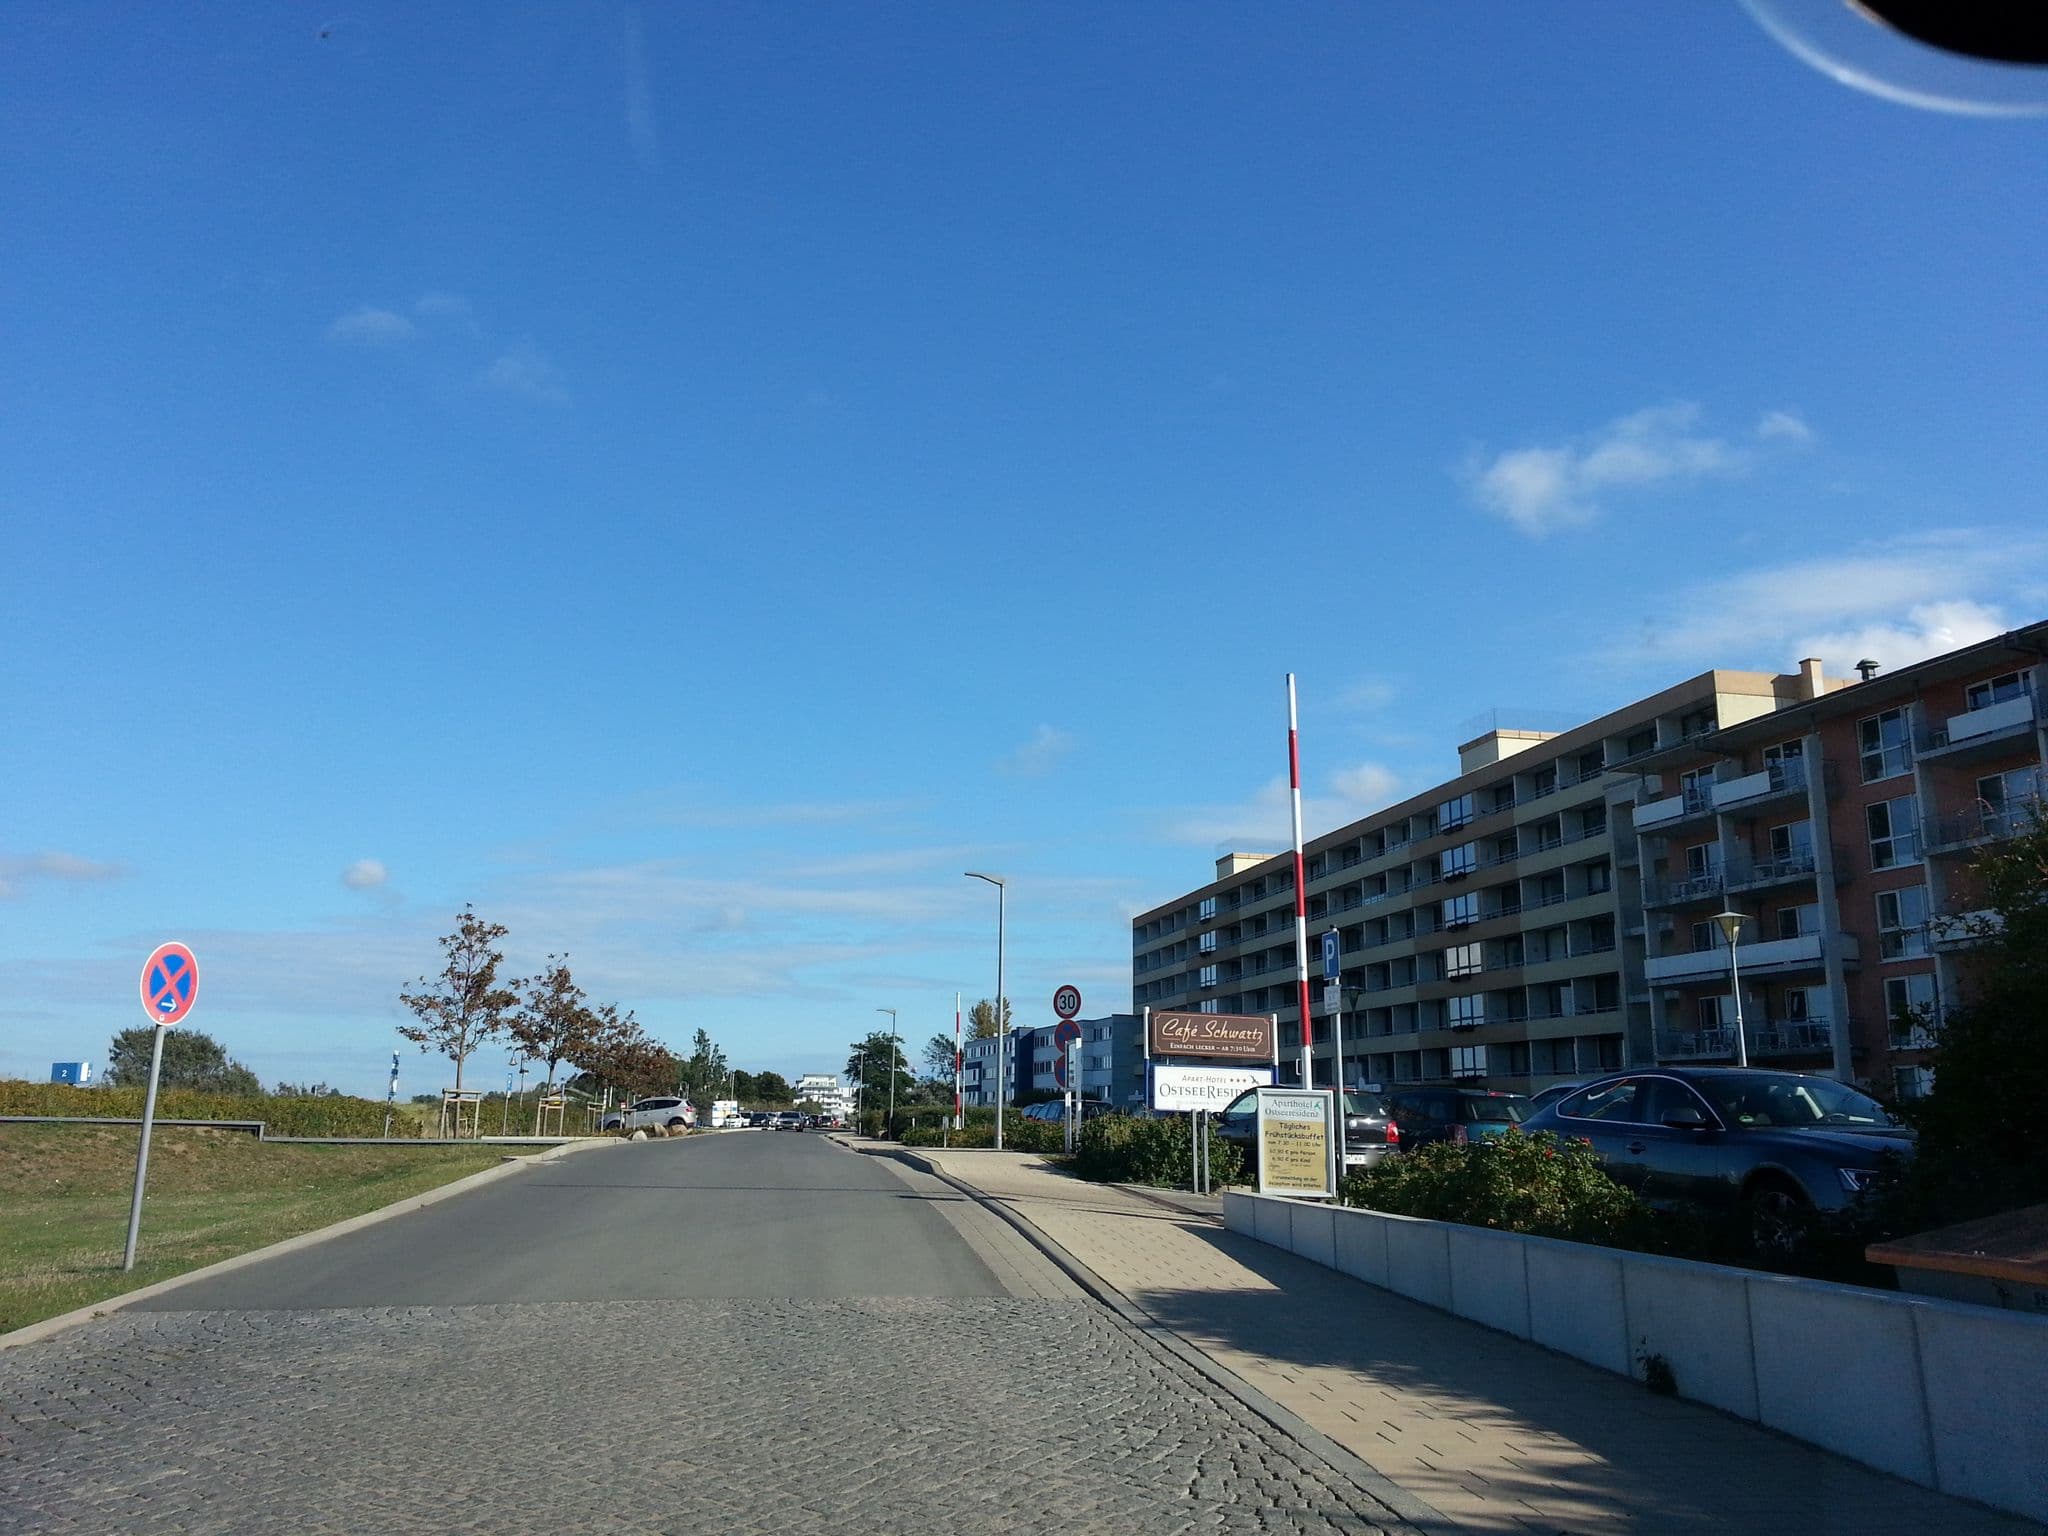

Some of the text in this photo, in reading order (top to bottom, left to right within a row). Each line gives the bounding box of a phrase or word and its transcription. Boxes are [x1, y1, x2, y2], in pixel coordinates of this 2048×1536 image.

[1325, 938, 1335, 974] P
[1059, 994, 1076, 1010] 30
[1162, 1018, 1264, 1047] Café Schwartz
[61, 1069, 68, 1078] 2
[1159, 1083, 1243, 1099] OSTSEERESID
